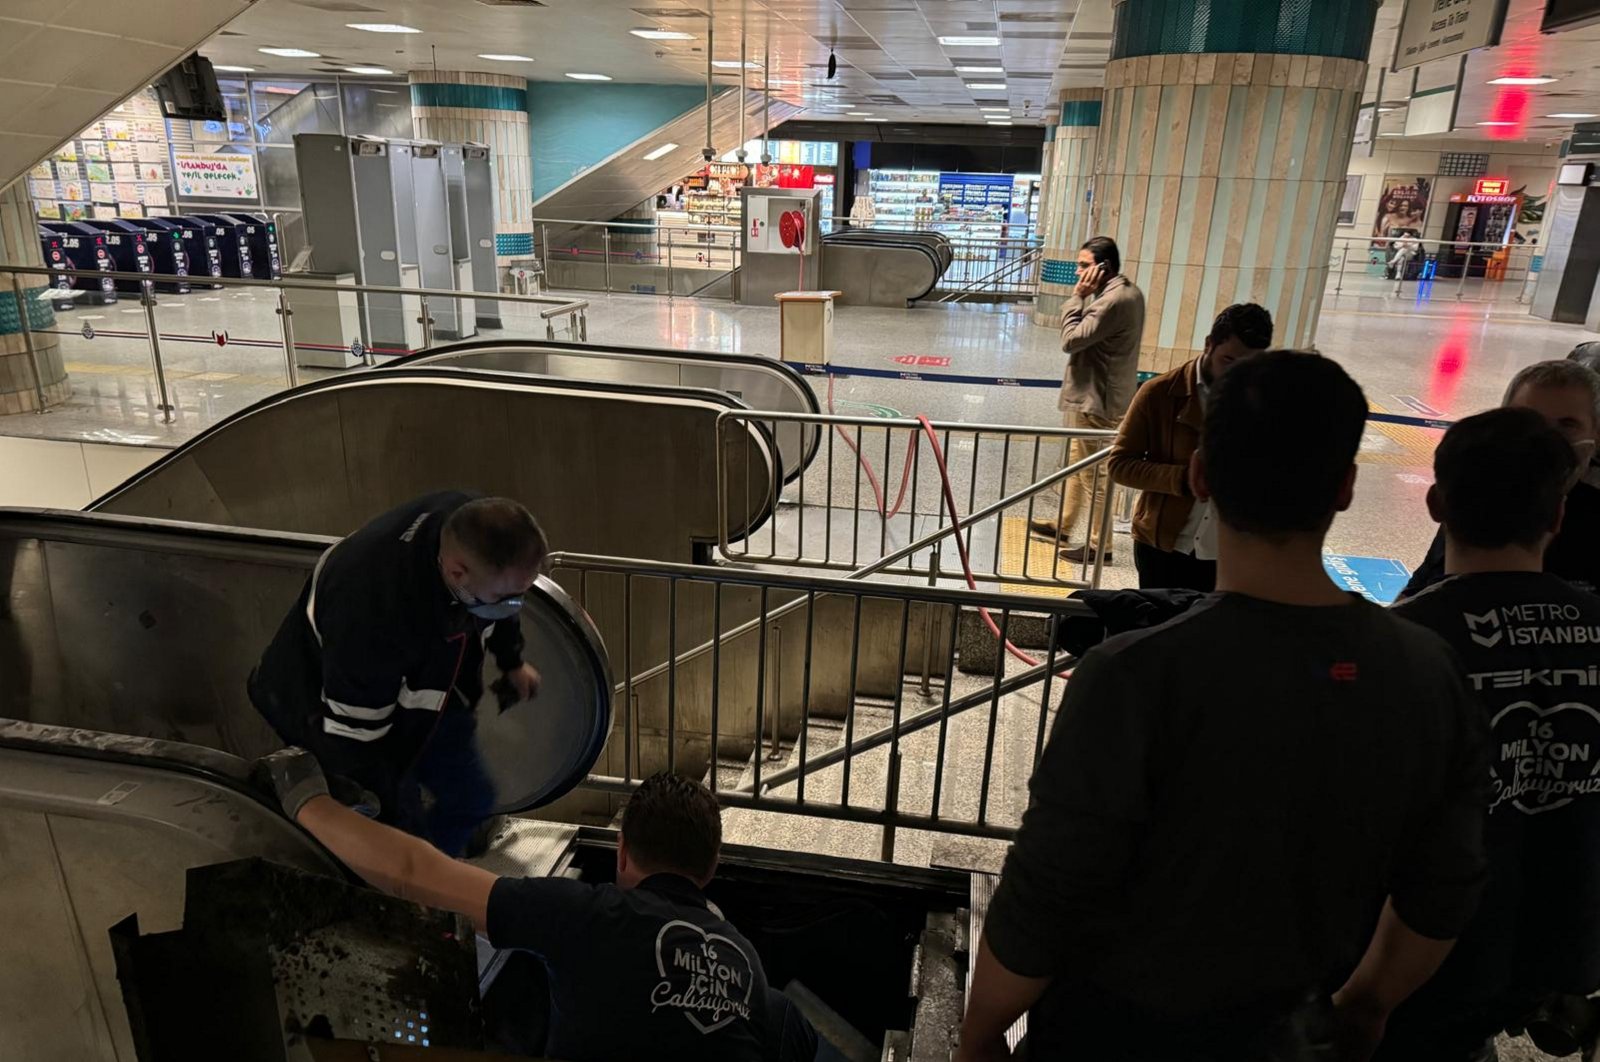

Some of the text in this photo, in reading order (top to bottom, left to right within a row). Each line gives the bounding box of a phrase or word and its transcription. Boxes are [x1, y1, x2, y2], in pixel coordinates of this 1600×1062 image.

[1501, 603, 1580, 622] METRO
[1527, 719, 1555, 739] 16
[700, 943, 718, 960] 16
